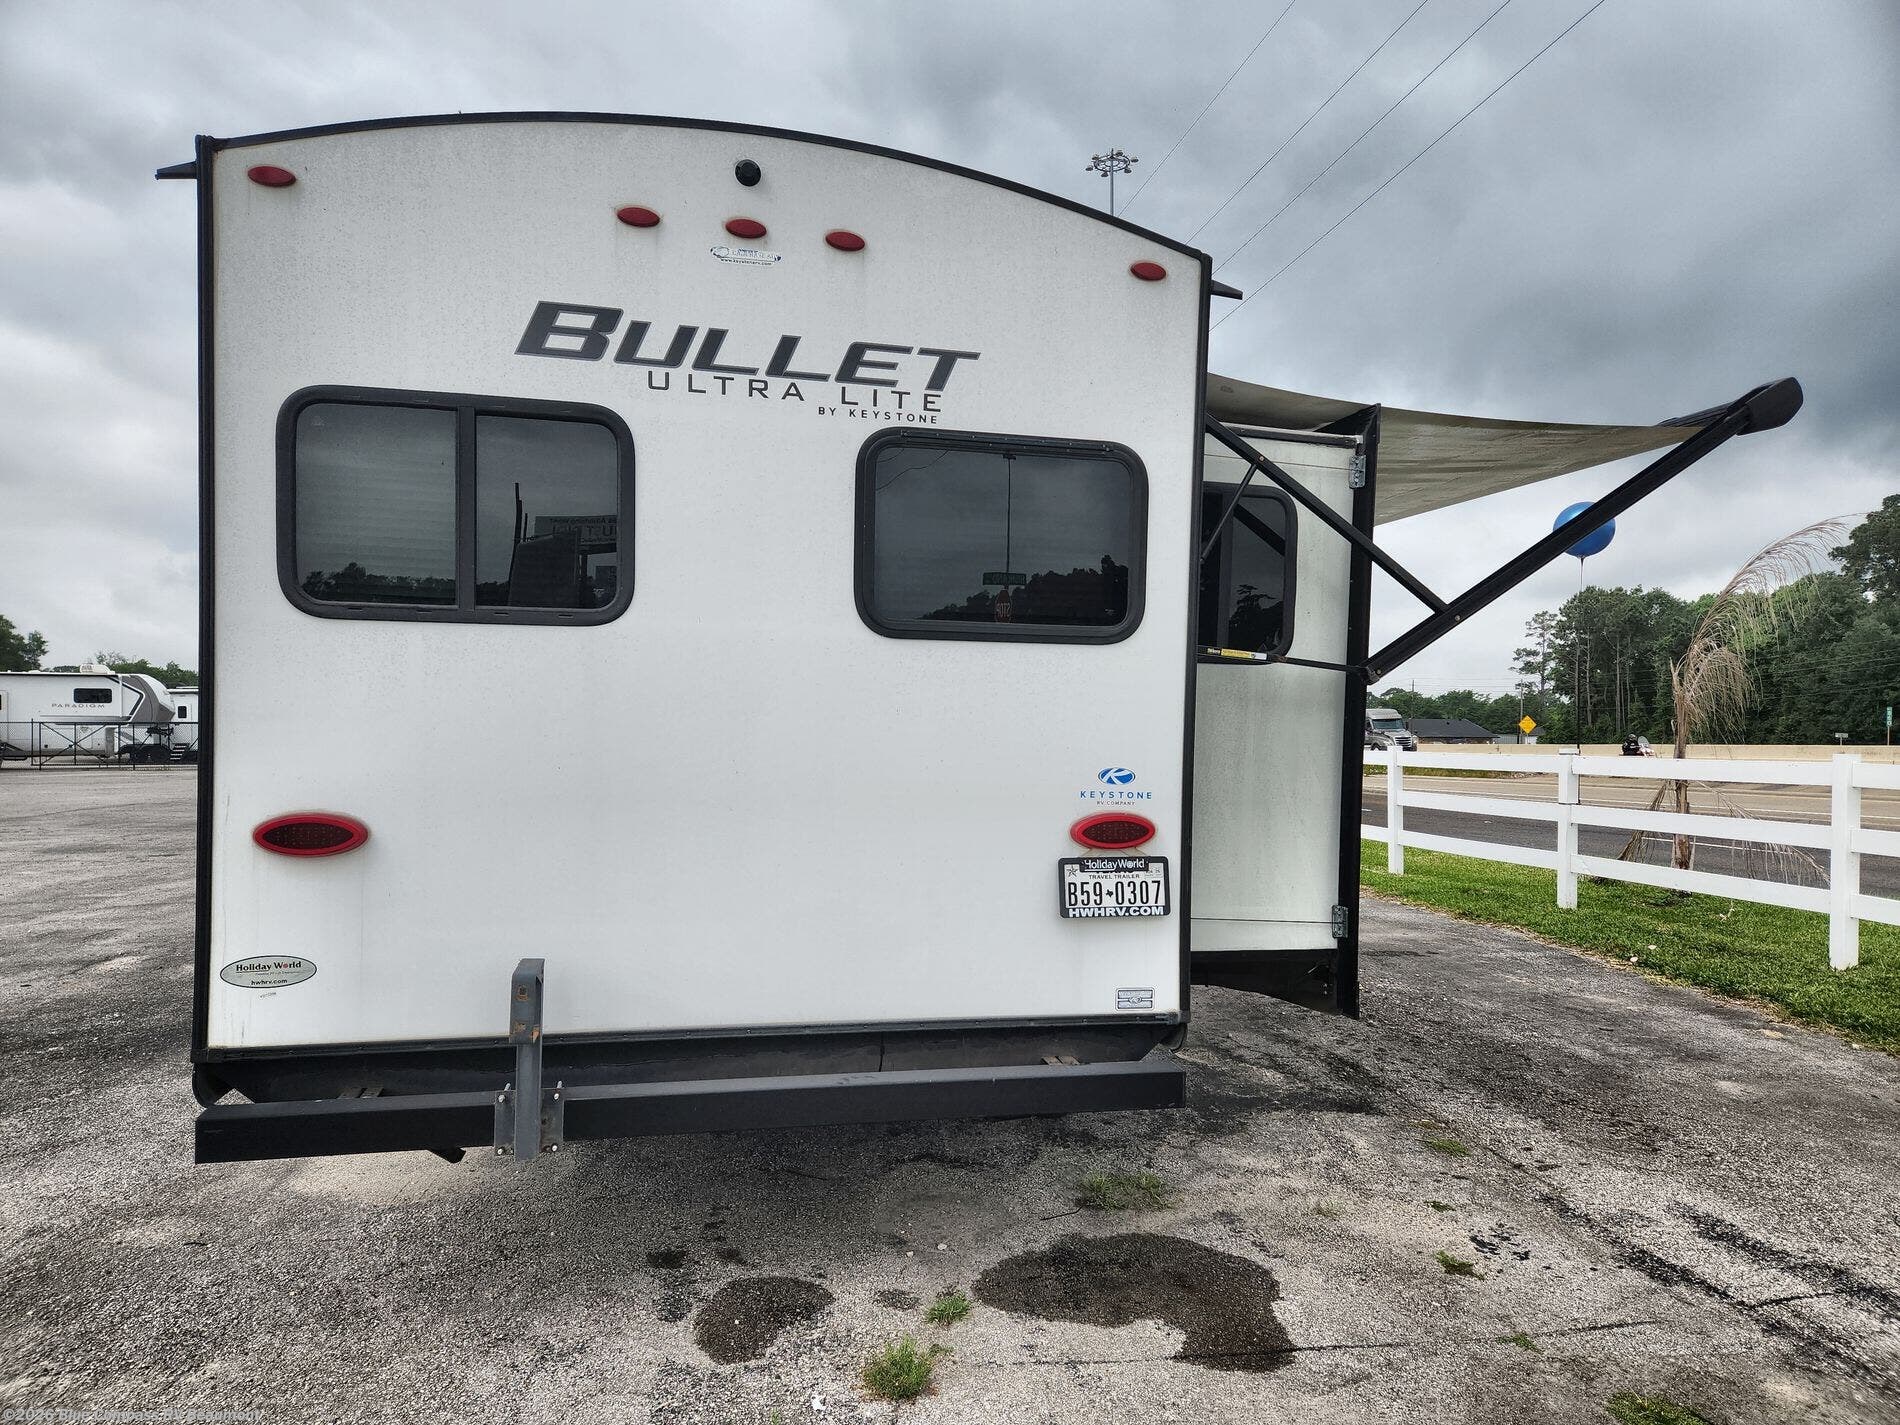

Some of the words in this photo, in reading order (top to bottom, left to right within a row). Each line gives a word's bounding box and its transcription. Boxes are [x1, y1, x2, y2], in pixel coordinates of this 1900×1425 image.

[514, 301, 981, 392] BULLET
[647, 371, 805, 401] ULTRA
[841, 386, 942, 412] LITE
[818, 406, 837, 416] BY
[849, 408, 937, 424] KEYSTONE
[1080, 790, 1152, 800] KEYSTONE
[1068, 906, 1164, 918] HWHRV.COM
[236, 963, 272, 972] Holiday
[273, 961, 302, 969] World
